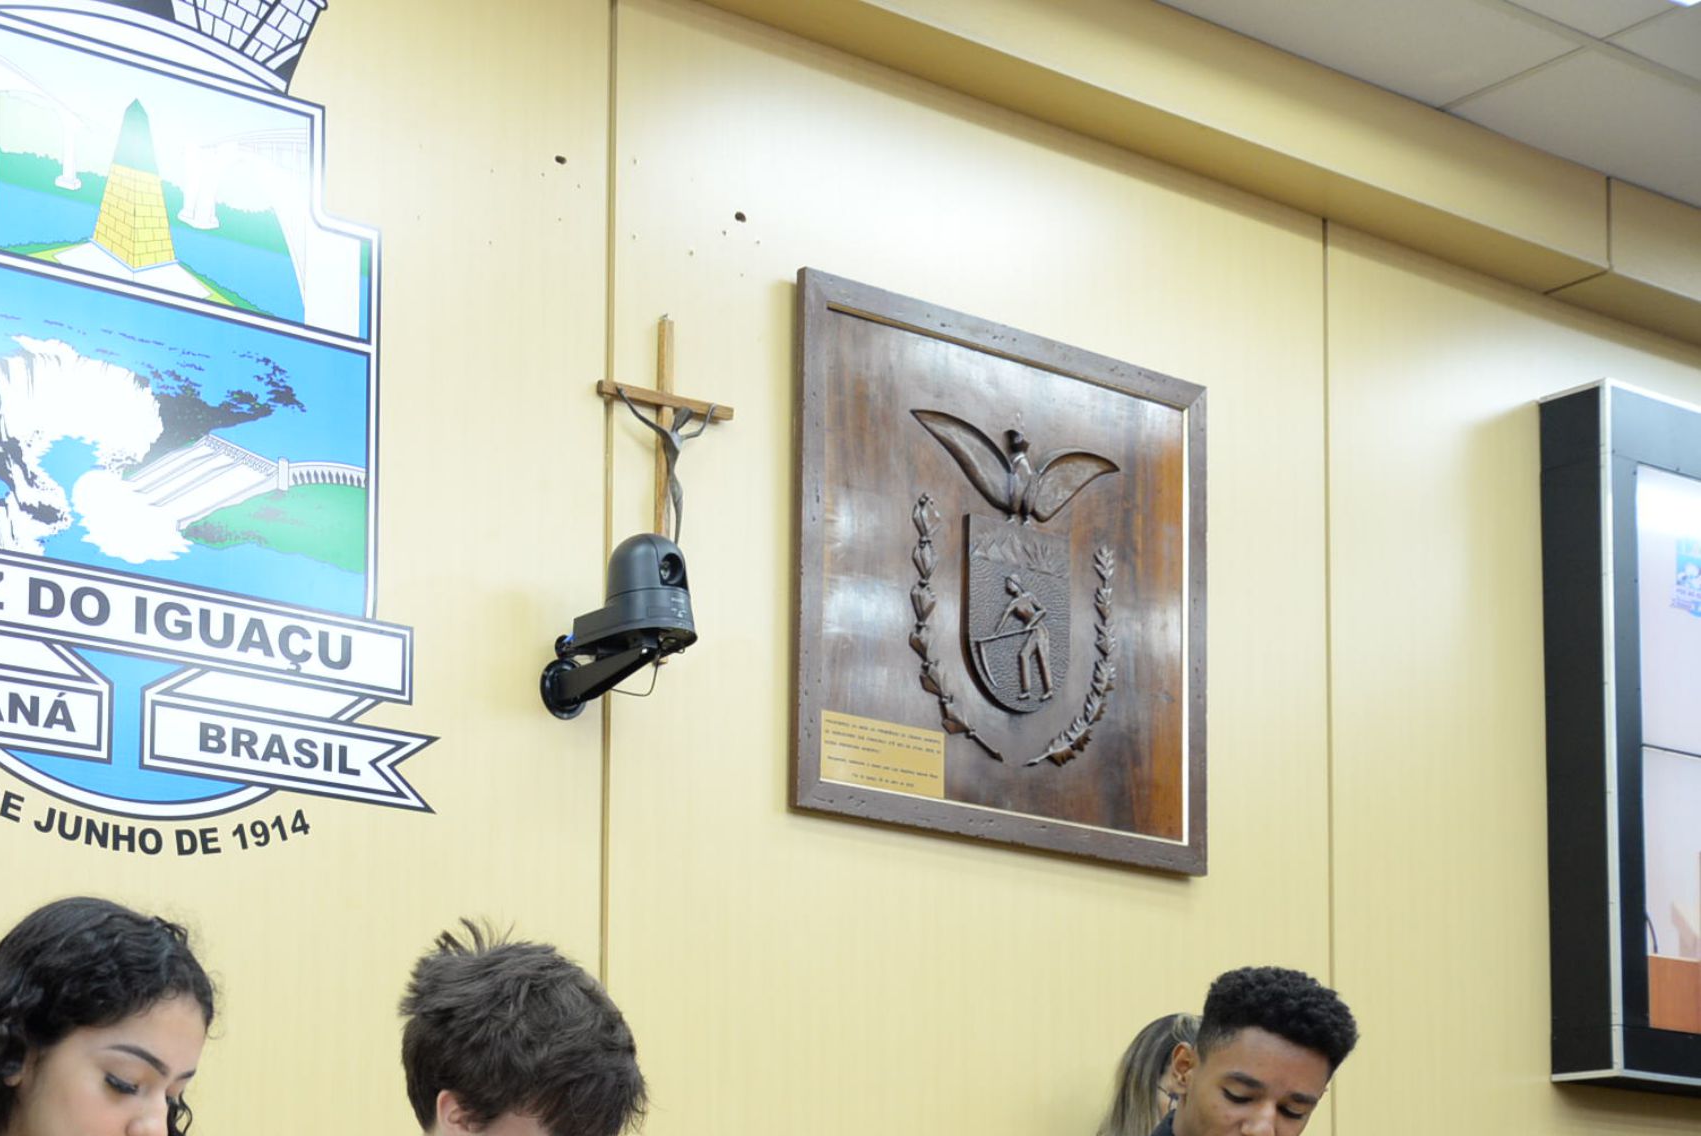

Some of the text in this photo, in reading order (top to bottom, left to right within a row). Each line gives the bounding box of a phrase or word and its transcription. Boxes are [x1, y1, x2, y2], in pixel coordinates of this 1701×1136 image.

[28, 577, 110, 626] DO
[134, 597, 353, 672] IGUAÇU
[199, 722, 360, 776] BRASIL
[34, 807, 164, 855] JUNHO
[176, 828, 221, 856] DE
[231, 809, 310, 850] 1914
